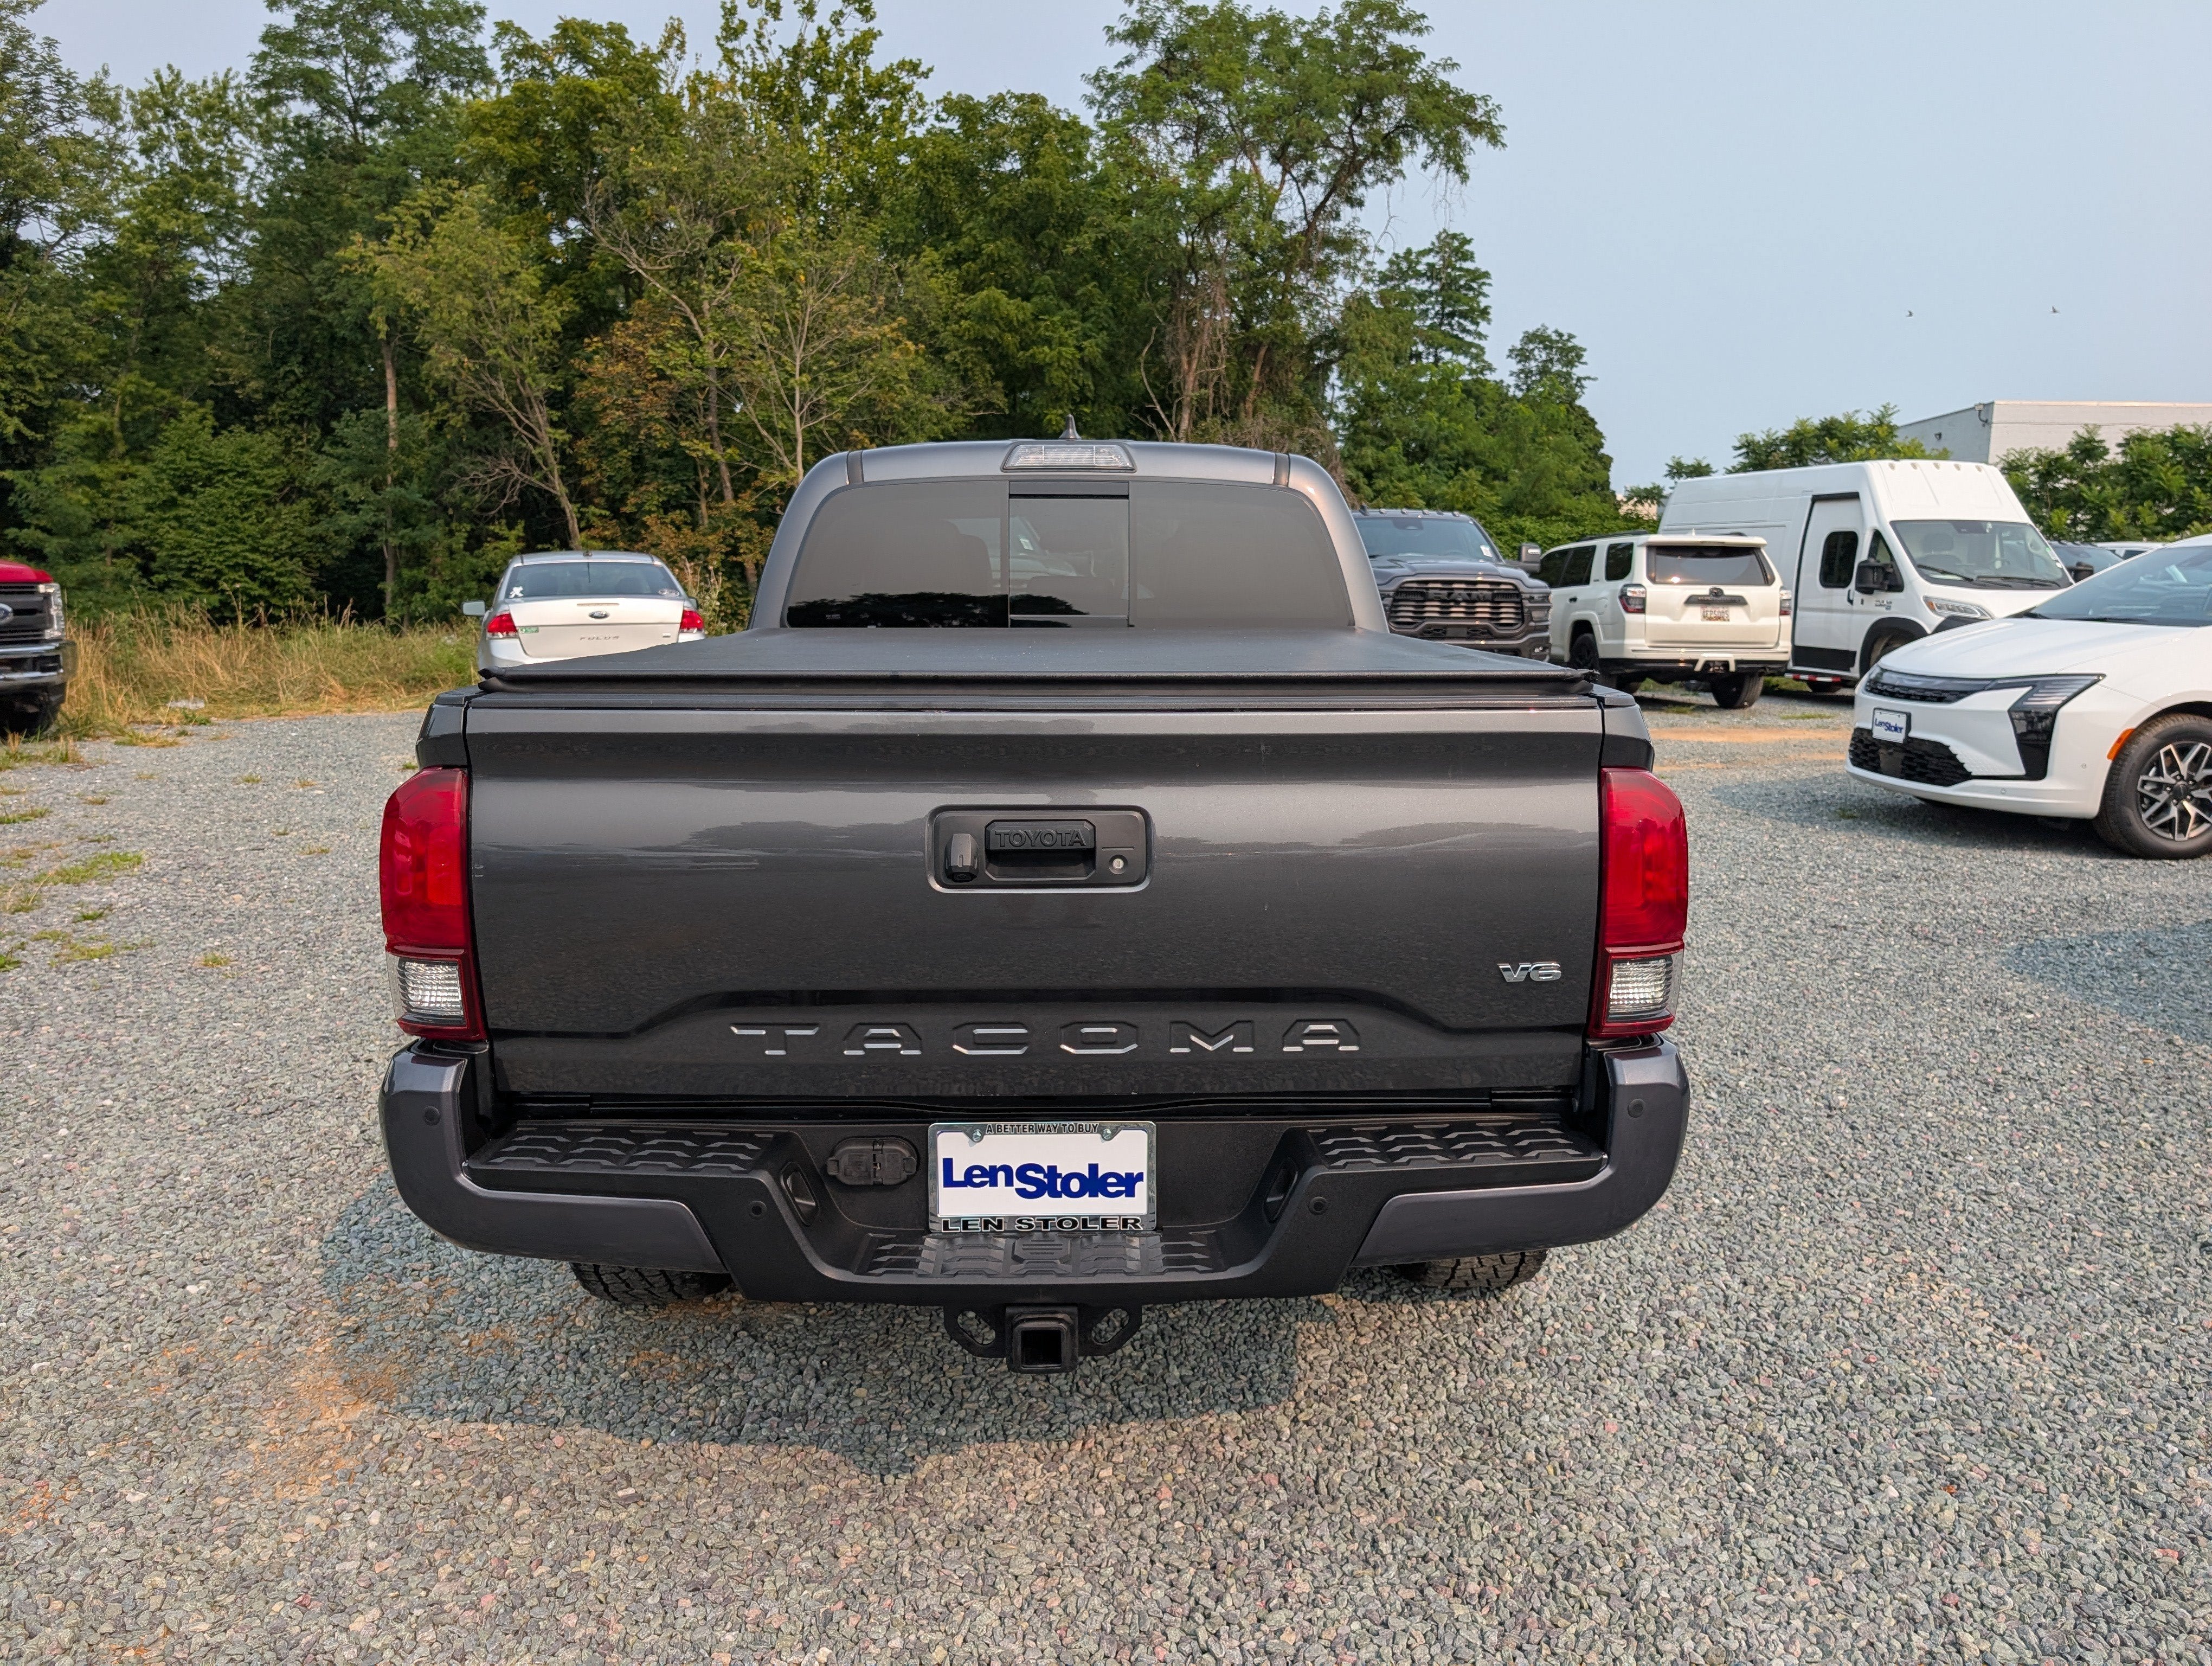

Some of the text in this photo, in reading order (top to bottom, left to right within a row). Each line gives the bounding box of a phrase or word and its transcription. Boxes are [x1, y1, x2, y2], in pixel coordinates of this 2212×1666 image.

[1875, 717, 1904, 733] LenStoler
[994, 829, 1086, 848] TOYOTA
[1497, 962, 1561, 982] V6
[730, 1018, 1360, 1055] TACOMA
[986, 1123, 1099, 1134] A BETTER WAY TO BUY
[942, 1216, 1143, 1232] LEN STOLER
